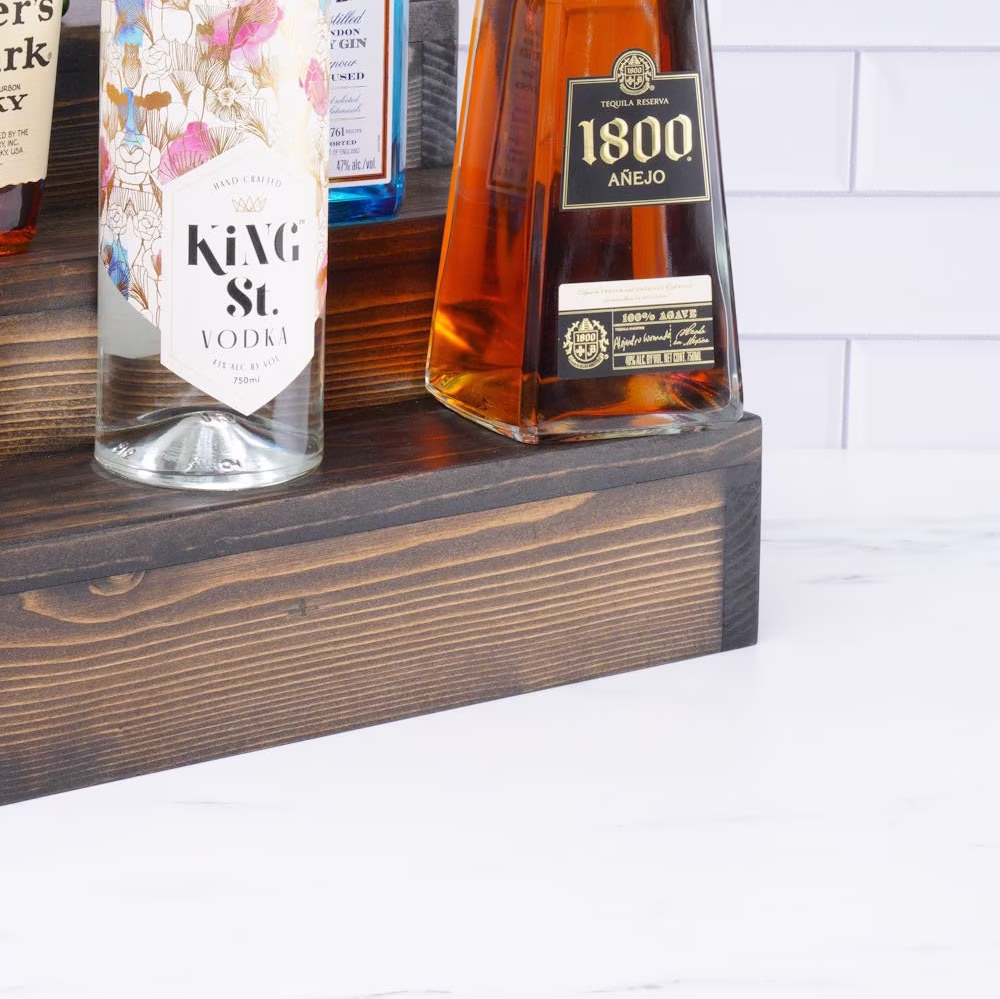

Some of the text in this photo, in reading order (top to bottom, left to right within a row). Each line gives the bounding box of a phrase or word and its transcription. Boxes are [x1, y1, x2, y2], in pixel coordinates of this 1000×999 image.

[330, 28, 360, 36] NDON
[339, 38, 367, 49] GIN
[331, 72, 365, 81] USED
[627, 67, 642, 75] 1800
[601, 98, 669, 109] TEQUILA RESERVA
[330, 127, 344, 138] 761
[578, 113, 693, 166] 1800
[11, 147, 24, 155] USA
[608, 169, 666, 187] AÑEJO
[227, 276, 279, 318] St.
[622, 308, 697, 323] 100% AGAVE
[202, 326, 287, 349] VODKA
[576, 332, 596, 342] 1800
[233, 376, 260, 384] 750ml
